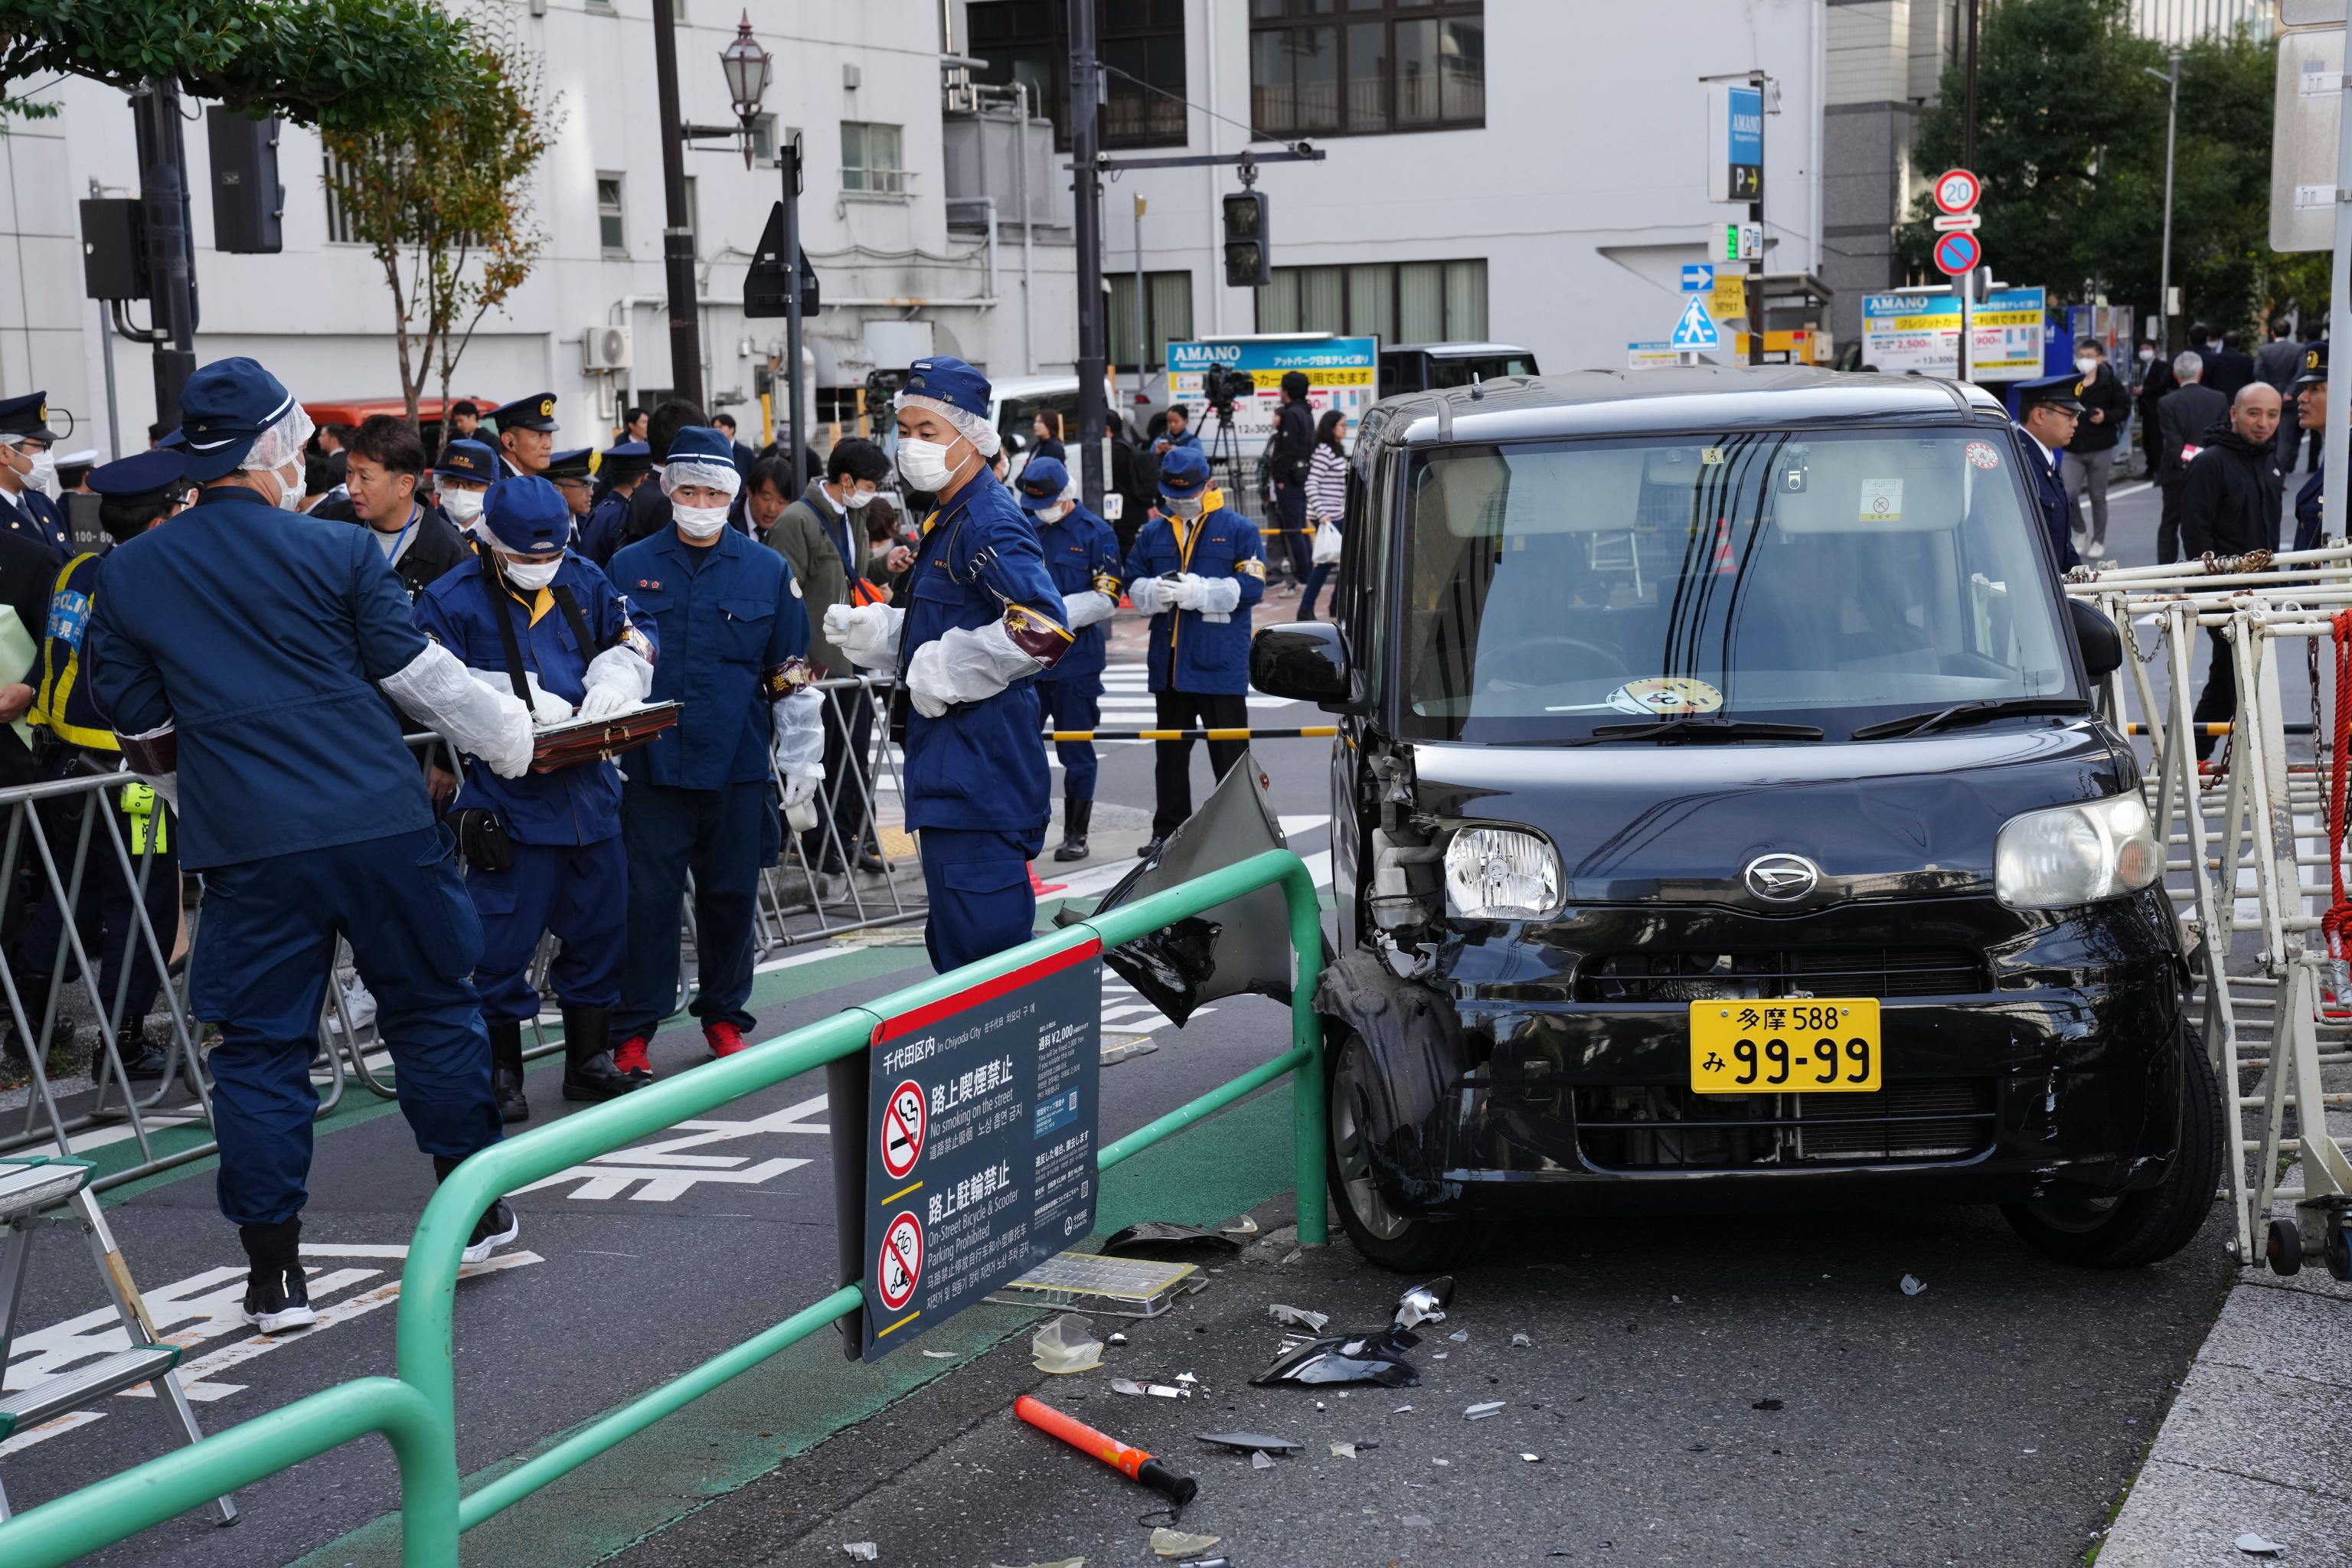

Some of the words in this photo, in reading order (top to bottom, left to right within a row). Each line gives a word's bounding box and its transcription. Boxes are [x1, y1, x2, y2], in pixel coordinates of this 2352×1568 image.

[1733, 114, 1761, 135] AMANO
[1736, 167, 1745, 192] P
[1945, 182, 1969, 202] 20
[1870, 297, 1929, 310] AMANO
[1174, 345, 1241, 361] AMANO
[985, 1016, 1003, 1033] 在千代田
[1006, 1009, 1021, 1024] 치요다
[1736, 1007, 1787, 1031] 多摩
[1793, 1006, 1838, 1030] 588
[938, 1043, 943, 1054] In
[945, 1033, 969, 1050] Chiyoda
[970, 1027, 981, 1039] City
[1052, 1024, 1073, 1045] ¥2,000
[883, 1036, 935, 1075] 千代田区内
[1702, 1052, 1726, 1072] み
[1733, 1037, 1870, 1085] 99-99
[931, 1054, 1013, 1116] 路上喫煙禁止
[930, 1123, 940, 1138] No
[942, 1111, 970, 1133] smoking
[973, 1107, 981, 1120] on
[983, 1096, 992, 1112] the
[994, 1088, 1013, 1108] street
[978, 1119, 992, 1137] 노상
[994, 1111, 1007, 1129] 흡연
[1009, 1102, 1022, 1122] 금지
[929, 1126, 973, 1161] 道路禁止吸烟
[1036, 1130, 1089, 1167] 違反した場合、撤去します
[928, 1159, 1009, 1225] 路上駐輪禁止
[928, 1218, 961, 1247] On-Street
[963, 1204, 986, 1230] Bicycle
[988, 1200, 993, 1215] &
[995, 1189, 1019, 1212] Scooter
[927, 1222, 1026, 1289] 马路禁止停放自行车和小型摩托车
[928, 1245, 954, 1268] Parking
[956, 1220, 990, 1254] Prohibited
[927, 1292, 943, 1310] 자전거
[952, 1278, 967, 1296] 원동기
[969, 1273, 979, 1287] 장치
[981, 1262, 995, 1280] 자전거
[997, 1255, 1007, 1270] 노상
[1008, 1248, 1018, 1265] 주차
[1019, 1240, 1029, 1257] 금지
